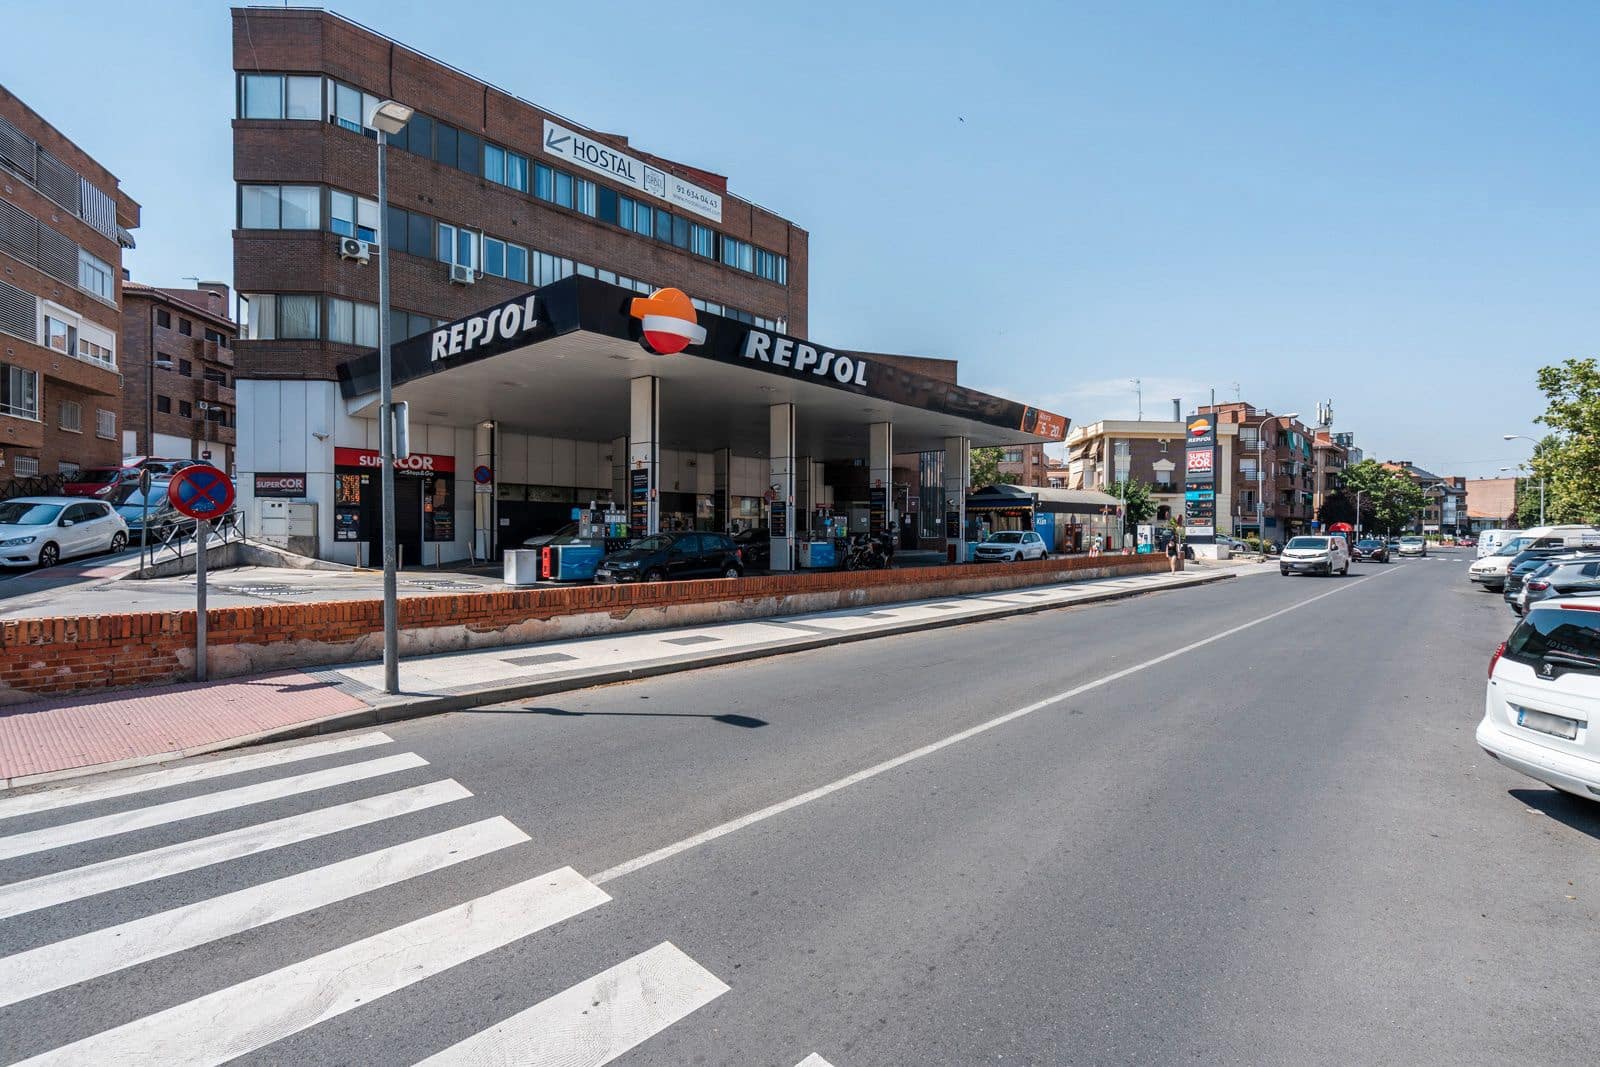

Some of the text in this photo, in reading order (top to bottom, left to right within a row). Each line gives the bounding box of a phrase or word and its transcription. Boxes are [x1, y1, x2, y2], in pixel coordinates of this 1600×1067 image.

[573, 138, 635, 180] HOSTAL
[676, 184, 685, 194] 91
[686, 190, 699, 200] 634
[700, 194, 709, 204] 04
[430, 296, 538, 363] REPSOL
[743, 329, 868, 388] REPSOL
[1189, 451, 1210, 460] SUPER
[1189, 458, 1210, 468] COR
[256, 478, 304, 489] SUPERCOR
